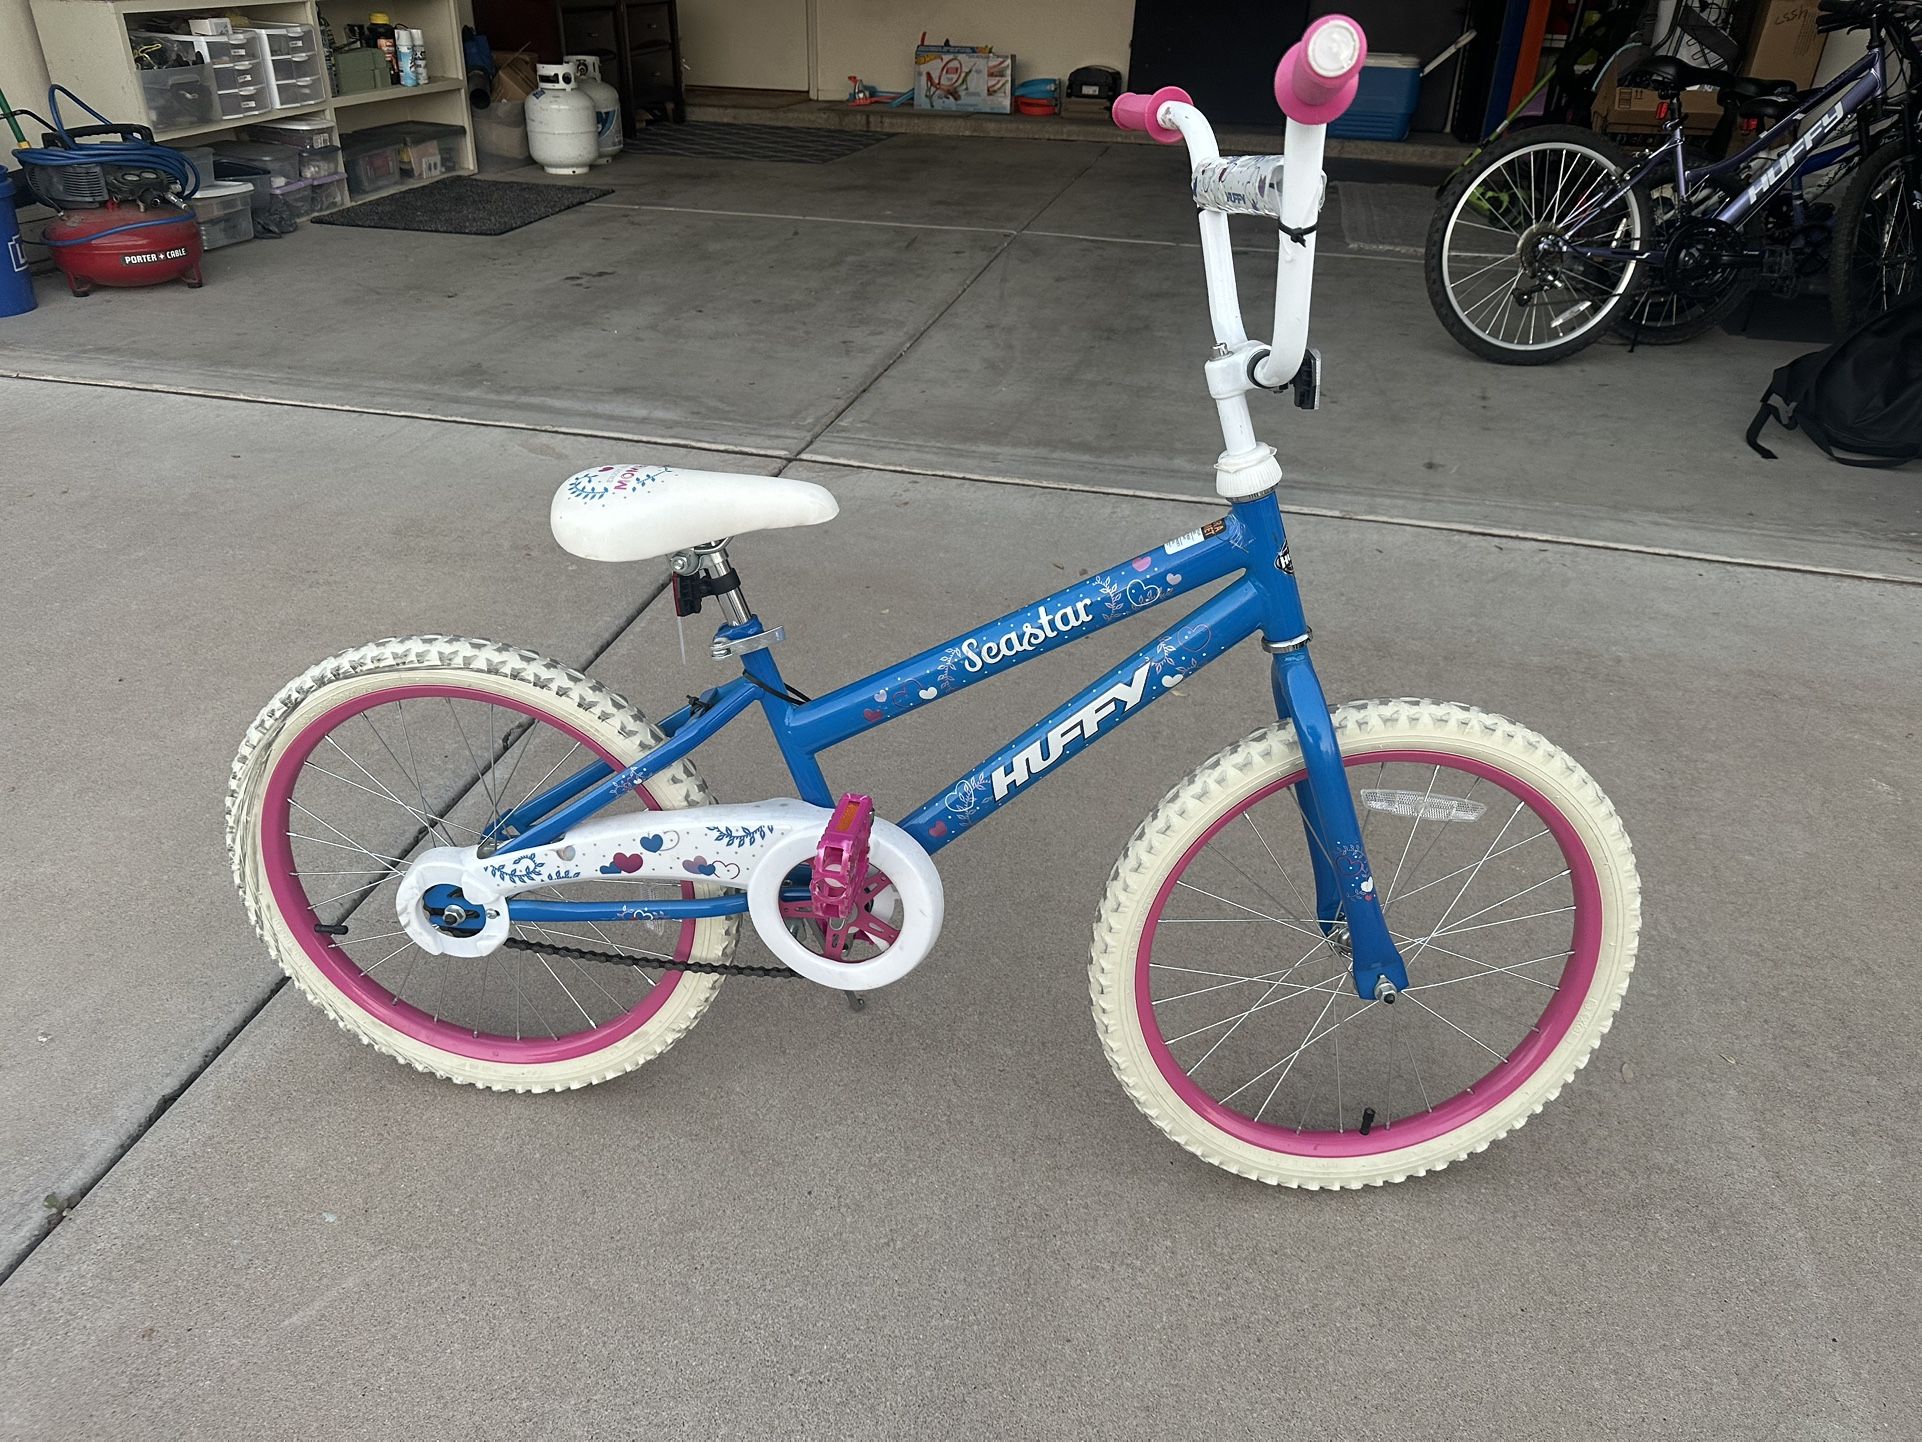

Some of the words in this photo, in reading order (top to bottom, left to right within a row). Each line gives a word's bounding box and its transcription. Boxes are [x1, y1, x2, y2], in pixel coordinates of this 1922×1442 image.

[1747, 100, 1844, 205] HUFFY
[124, 253, 158, 264] PORTER
[166, 247, 186, 259] CABLE
[961, 598, 1093, 672] Seastar
[991, 660, 1152, 802] HUFFY
